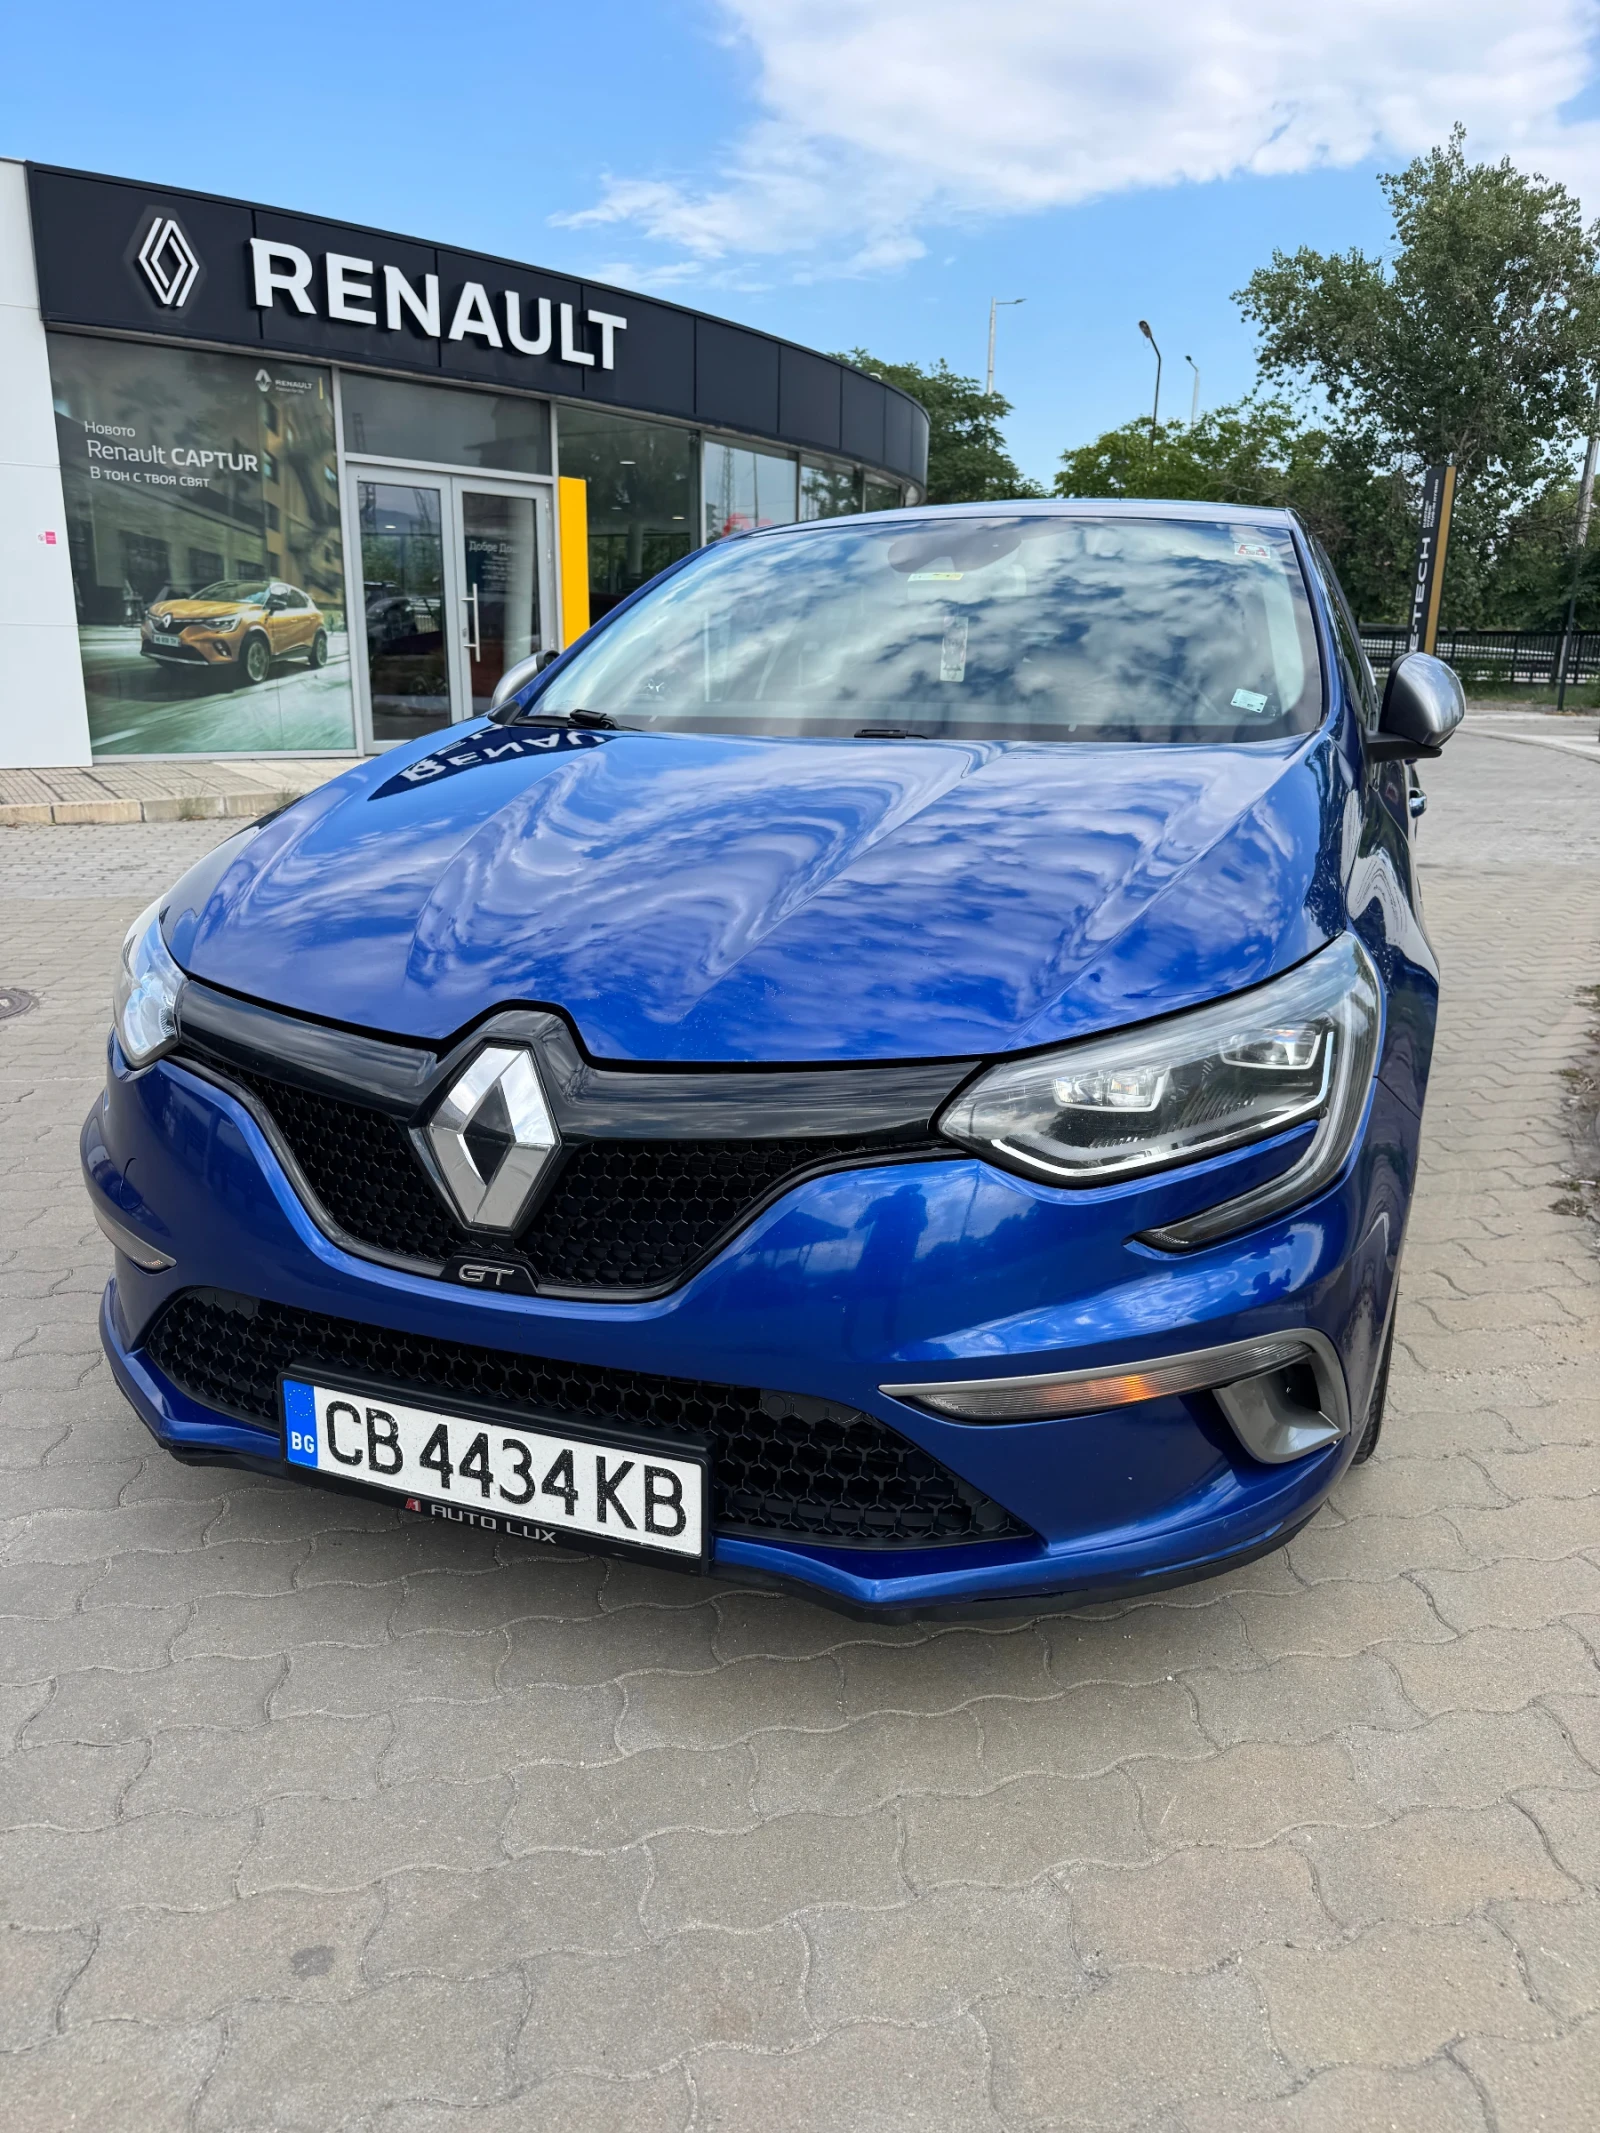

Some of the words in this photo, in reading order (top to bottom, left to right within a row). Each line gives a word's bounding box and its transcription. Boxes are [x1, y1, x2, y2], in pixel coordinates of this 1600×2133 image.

[250, 237, 627, 371] RENAULT
[275, 380, 312, 390] RENAULT
[84, 421, 136, 437] Новото
[86, 440, 166, 464] Renault
[171, 448, 258, 472] CAPTUR
[90, 466, 101, 479] В
[104, 470, 130, 482] тон
[133, 473, 142, 483] с
[144, 473, 177, 485] твоя
[179, 476, 210, 488] свят
[1409, 537, 1431, 651] E-TECH
[458, 1264, 515, 1286] GT
[291, 1431, 316, 1454] BG
[325, 1400, 403, 1476] CB
[419, 1424, 580, 1518] 4434
[596, 1455, 688, 1538] KB
[431, 1504, 496, 1530] AUTO
[506, 1521, 557, 1544] LUX
